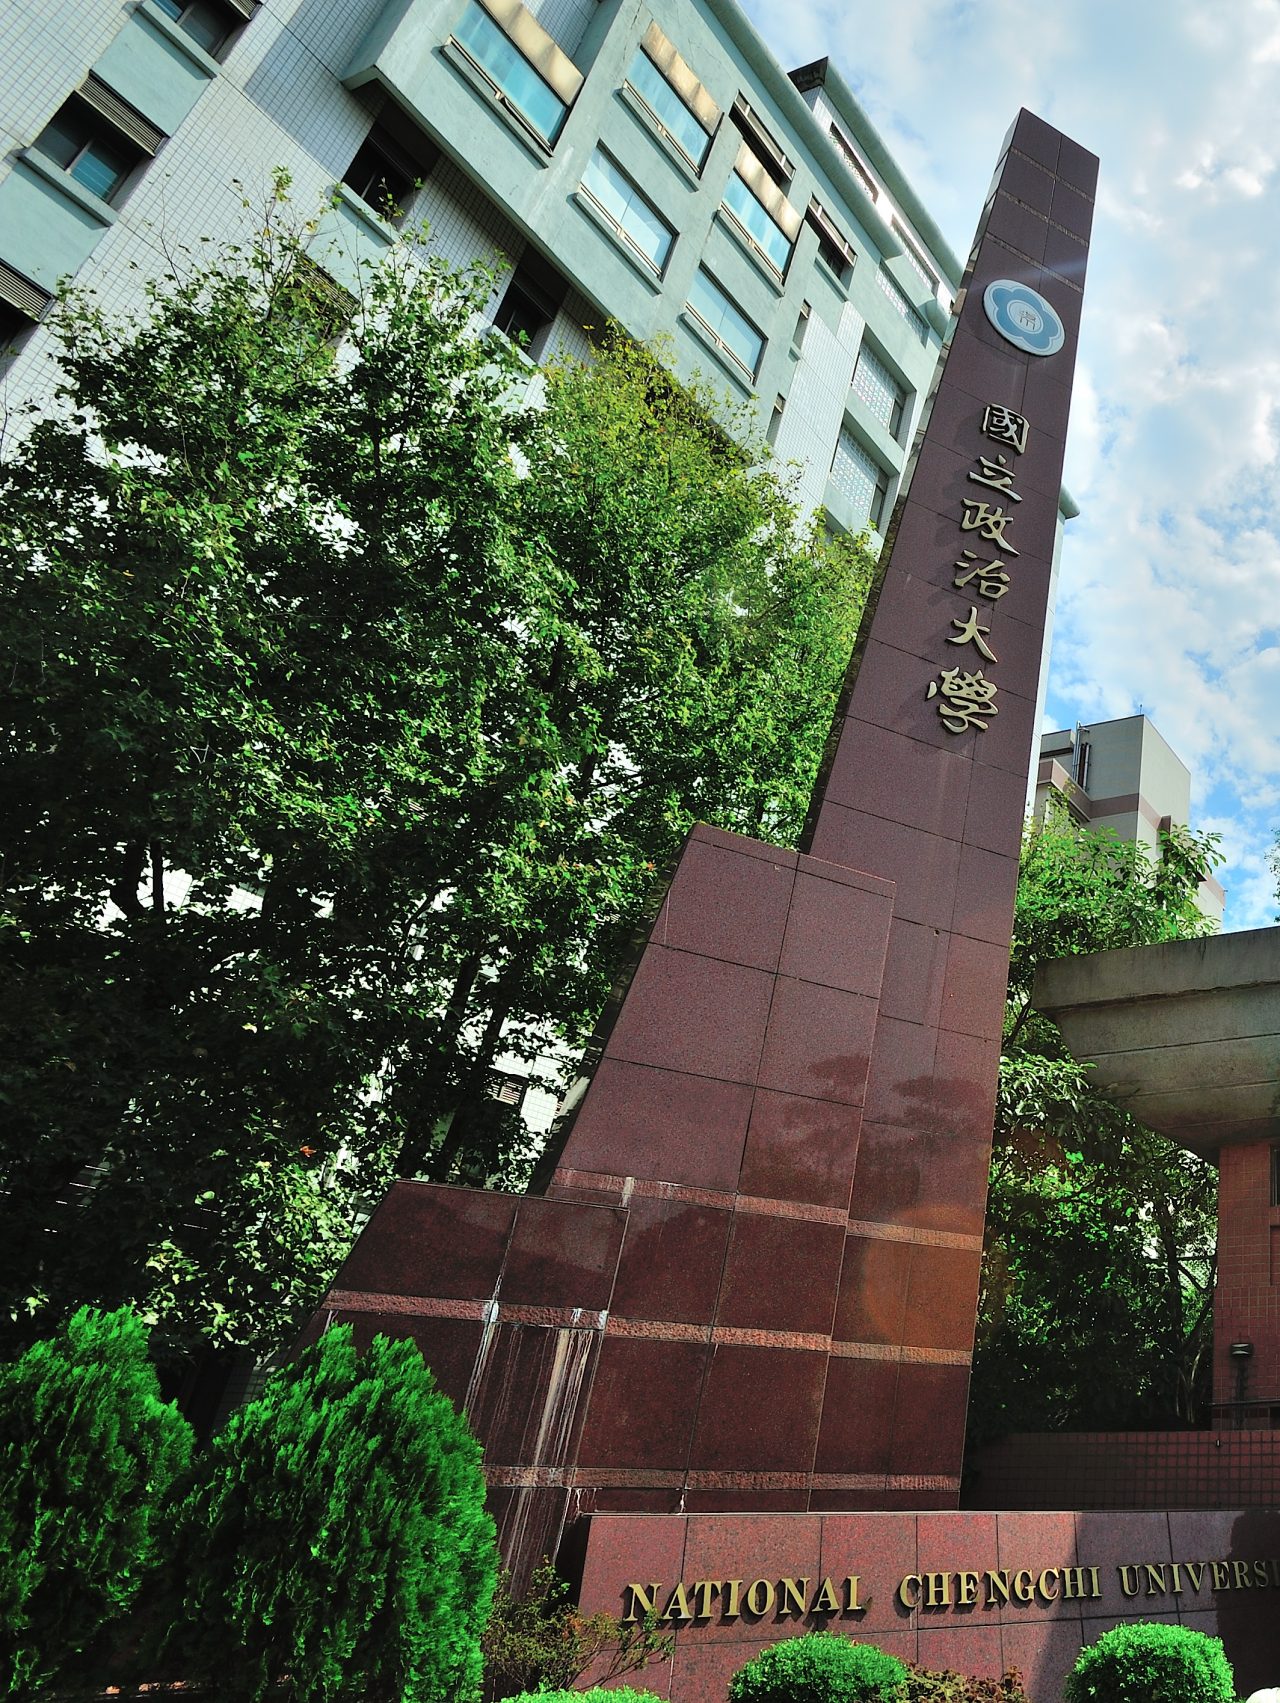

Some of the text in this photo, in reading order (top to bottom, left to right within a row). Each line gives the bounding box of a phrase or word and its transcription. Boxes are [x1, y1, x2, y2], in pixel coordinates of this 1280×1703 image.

[927, 403, 1031, 734] 國立政治大學
[622, 1575, 863, 1622] NATIONAL
[899, 1565, 1103, 1608] CHENGCHI
